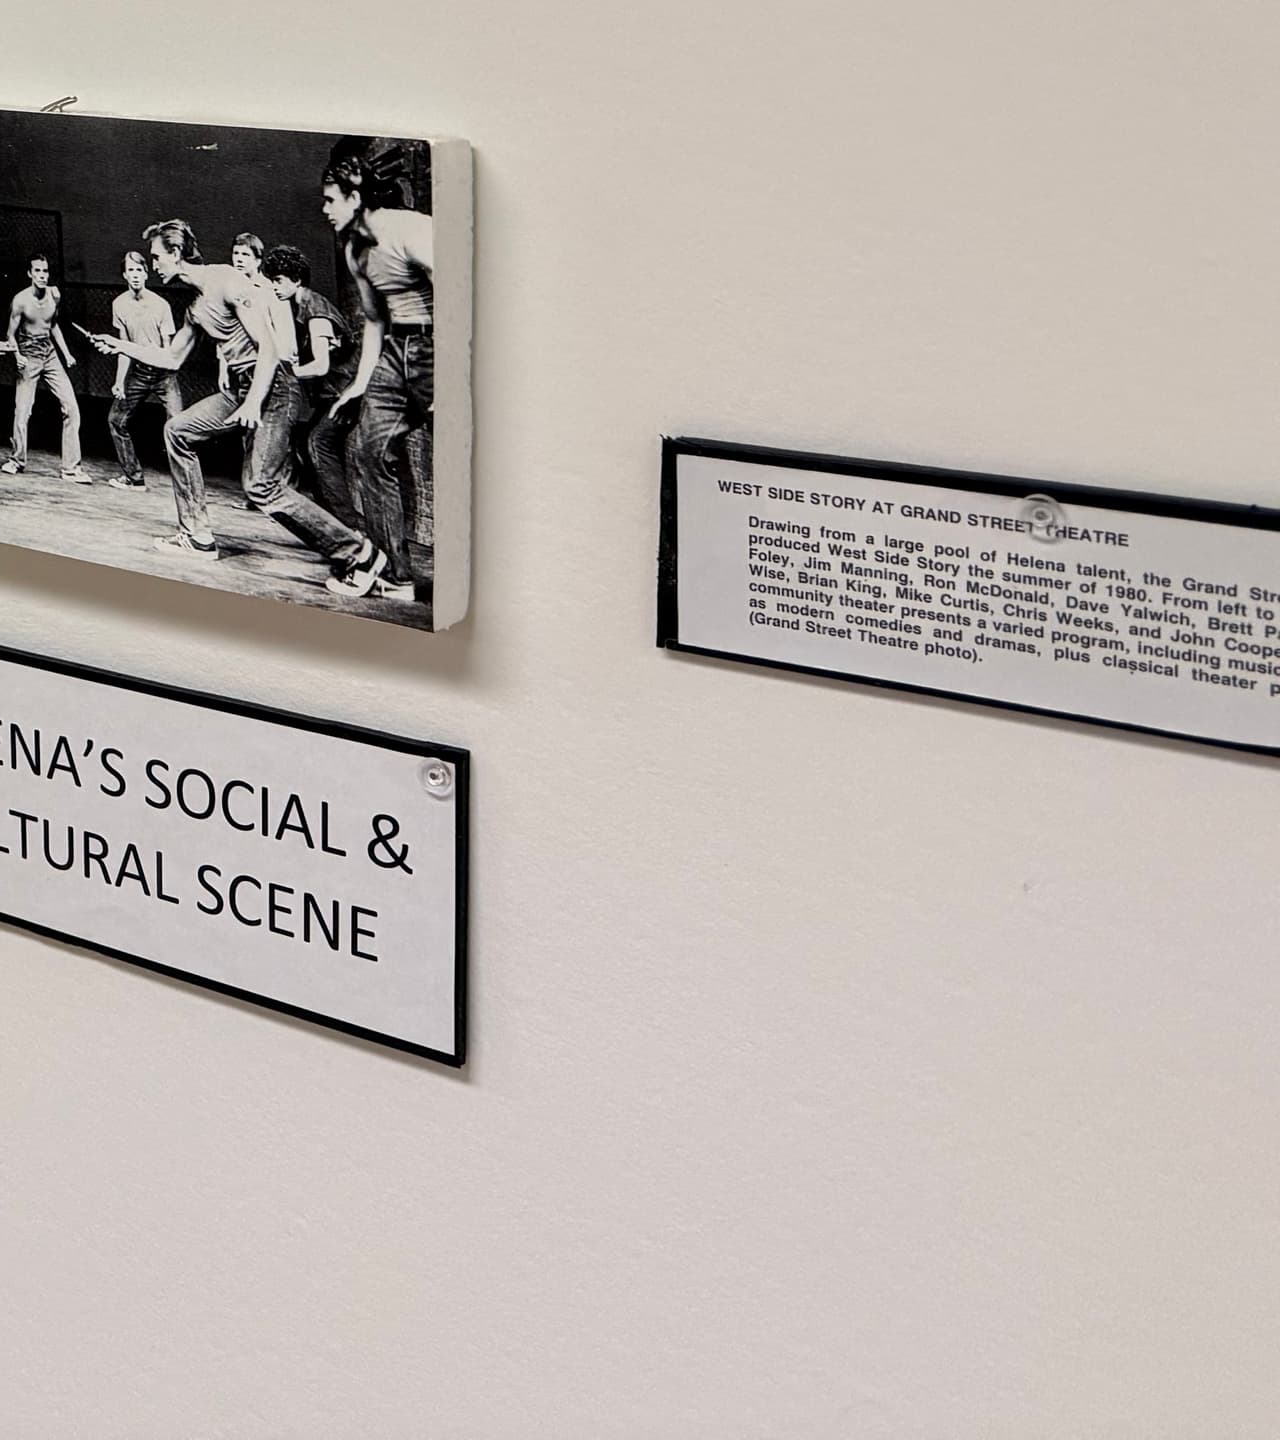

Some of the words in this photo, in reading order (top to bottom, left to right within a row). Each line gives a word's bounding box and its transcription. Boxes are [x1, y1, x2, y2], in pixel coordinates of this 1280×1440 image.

[717, 479, 763, 497] WEST
[767, 486, 805, 502] SIDE
[809, 491, 866, 511] STORY
[871, 500, 894, 515] AT
[899, 504, 961, 524] GRAND
[967, 513, 1033, 534] STREET
[748, 514, 811, 538] Drawing
[818, 525, 856, 542] from
[864, 534, 875, 545] a
[883, 534, 924, 555] large
[933, 541, 970, 562] pool
[979, 548, 997, 563] of
[1006, 552, 1066, 573] Helena
[1075, 562, 1131, 584] talent,
[1141, 571, 1172, 588] the
[1181, 577, 1238, 598] Grand
[1248, 587, 1280, 604] Str
[748, 531, 820, 556] produced
[827, 542, 866, 560] West
[873, 549, 909, 567] Side
[916, 556, 960, 577] Story
[967, 563, 994, 579] the
[1001, 571, 1071, 591] summer
[1079, 580, 1096, 595] of
[1105, 584, 1152, 603] 1980.
[1162, 592, 1208, 611] From
[1217, 600, 1246, 617] left
[1255, 606, 1274, 621] to
[748, 547, 794, 569] Foley,
[802, 555, 831, 572] Jim
[840, 561, 913, 587] Manning,
[923, 573, 956, 591] Ron
[965, 580, 1055, 607] McDonald,
[1065, 595, 1109, 614] Dave
[1119, 603, 1196, 629] Yalwich,
[1207, 616, 1253, 636] Brett
[747, 563, 790, 583] Wise,
[796, 570, 839, 589] Brian
[845, 578, 887, 600] King,
[894, 586, 933, 604] Mike
[939, 593, 995, 615] Curtis,
[1001, 602, 1048, 622] Chris
[1054, 610, 1119, 635] Weeks,
[1127, 622, 1162, 640] and
[1168, 628, 1215, 648] John
[748, 579, 834, 608] community
[837, 593, 896, 615] theater
[899, 603, 972, 630] presents
[975, 618, 987, 629] a
[990, 618, 1045, 638] varied
[1050, 630, 1131, 655] program,
[1136, 640, 1221, 670] including
[748, 611, 799, 634] (Grand
[805, 620, 851, 640] Street
[857, 629, 918, 651] Theatre
[924, 640, 984, 664] photo).
[748, 598, 767, 610] as
[775, 600, 835, 621] modern
[844, 611, 922, 636] comedies
[931, 625, 963, 642] and
[973, 632, 1041, 657] dramas,
[1053, 645, 1091, 666] plus
[1101, 652, 1179, 678] classical
[1190, 667, 1258, 691] theater
[145, 758, 347, 858] SOCIAL
[367, 813, 414, 876] &
[196, 864, 379, 963] SCENE
